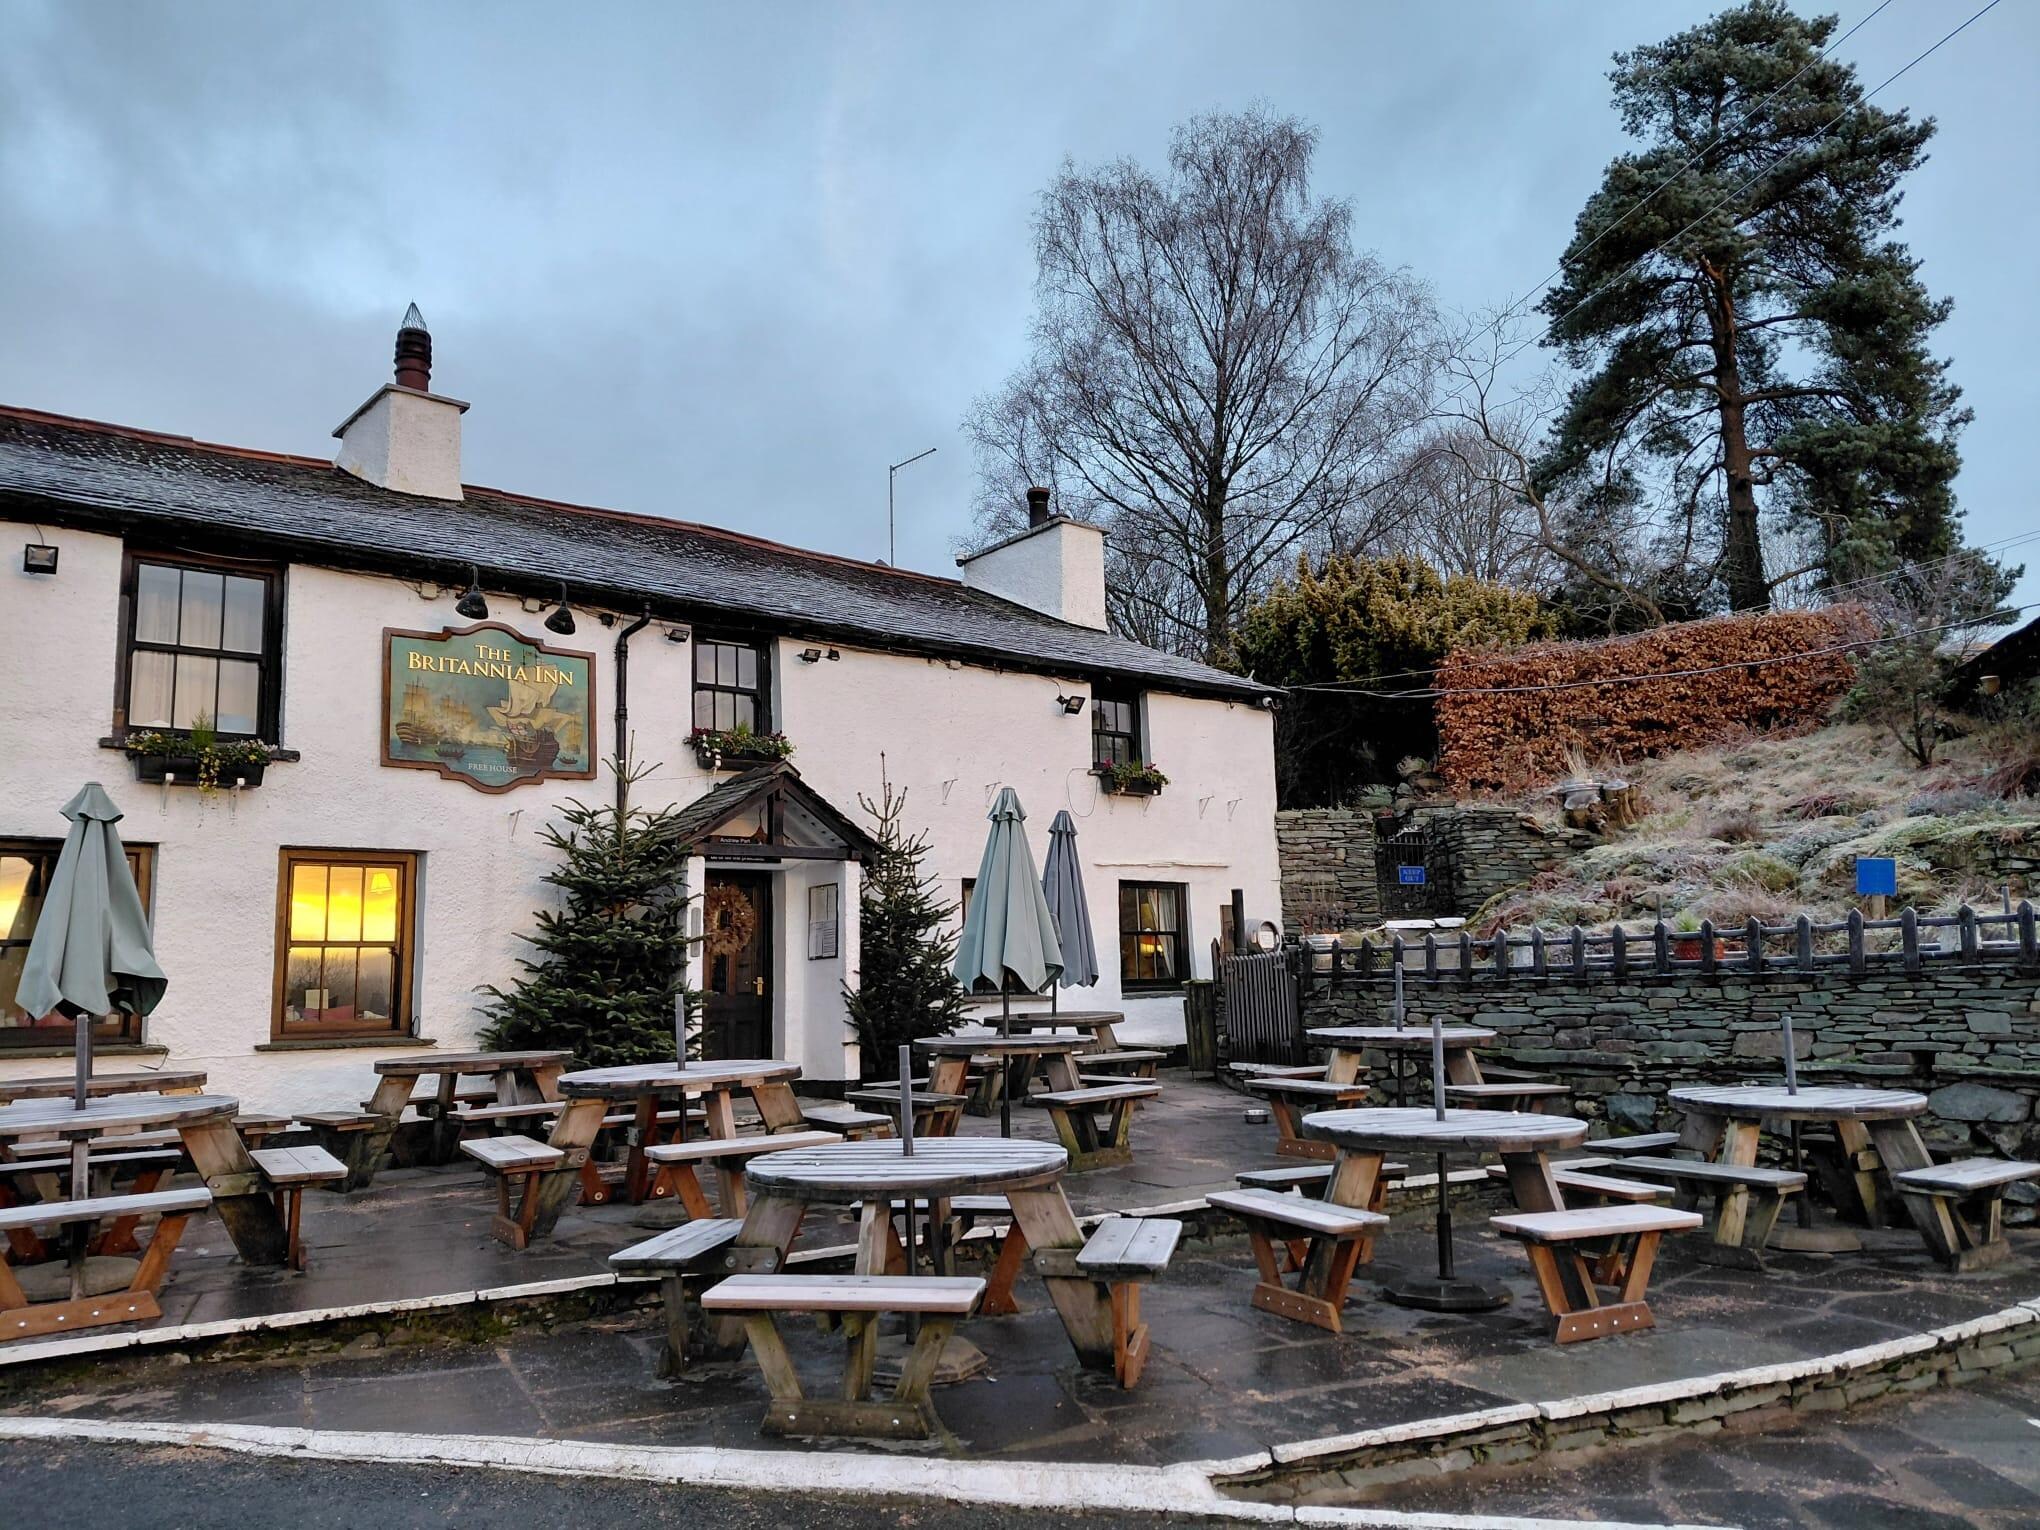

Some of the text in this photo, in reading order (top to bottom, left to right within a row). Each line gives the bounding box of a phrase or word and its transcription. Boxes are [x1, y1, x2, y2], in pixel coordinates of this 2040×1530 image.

[475, 644, 511, 661] THE
[408, 652, 574, 685] BRITANNIA INN
[468, 762, 518, 774] FREE HOUSE
